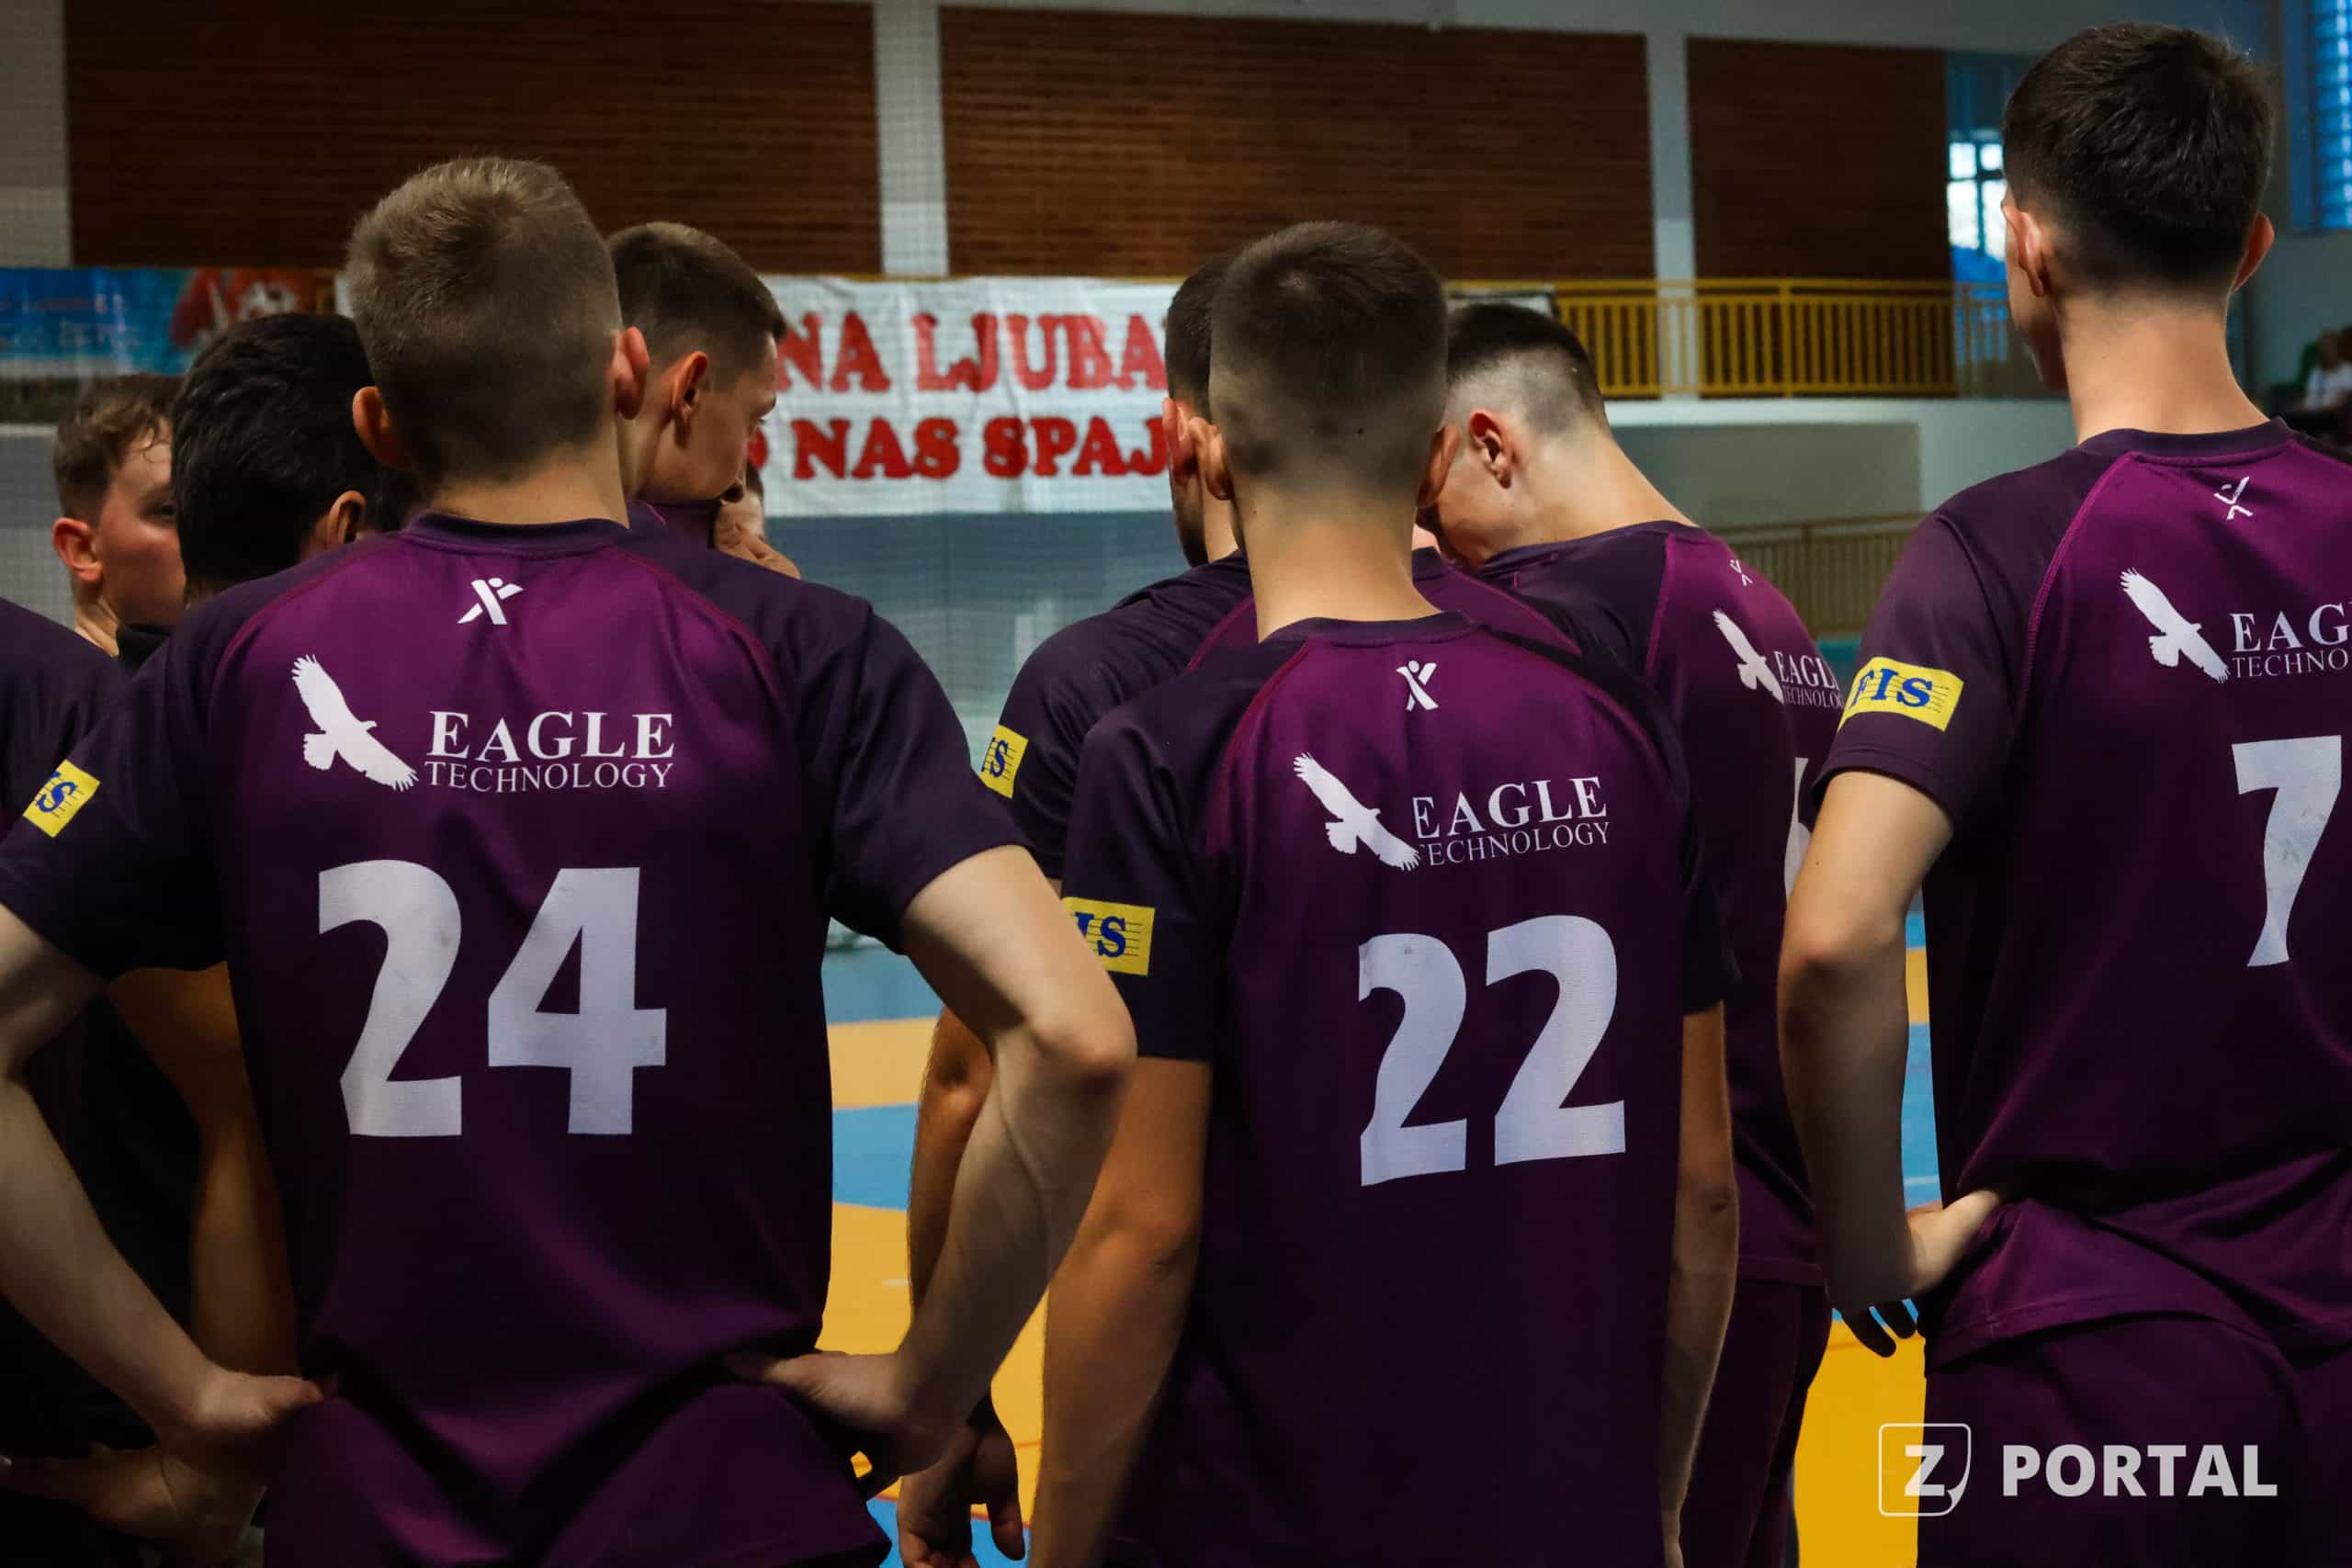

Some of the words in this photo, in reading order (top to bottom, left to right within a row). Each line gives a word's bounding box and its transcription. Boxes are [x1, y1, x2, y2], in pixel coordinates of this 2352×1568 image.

[910, 310, 1169, 393] LJUBA
[791, 416, 962, 479] NAS
[2229, 601, 2352, 652] EAG
[1772, 650, 1840, 691] EAGL
[2231, 647, 2352, 679] TECHNO
[424, 710, 675, 764] EAGLE
[424, 761, 675, 794] TECHNOLOGY
[1411, 776, 1608, 840] EAGLE
[1419, 821, 1610, 867] ECHNOLOGY
[2231, 734, 2343, 967] 7
[318, 859, 667, 1138] 24
[1357, 914, 1626, 1188] 22
